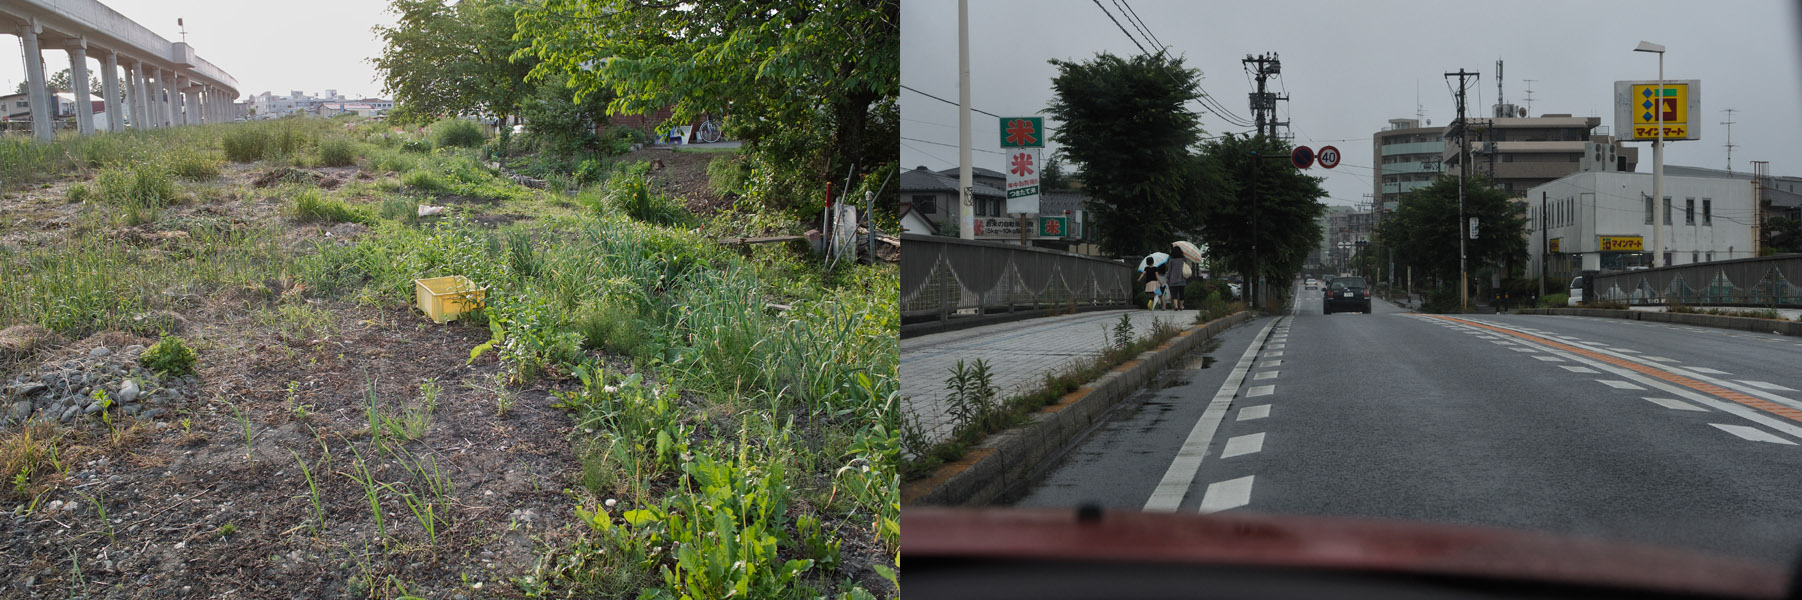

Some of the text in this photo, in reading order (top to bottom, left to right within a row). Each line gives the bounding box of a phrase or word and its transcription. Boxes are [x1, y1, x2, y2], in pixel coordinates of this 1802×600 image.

[1005, 119, 1037, 145] 米
[1636, 127, 1685, 136] マインマート
[1322, 152, 1336, 162] 40
[1011, 152, 1034, 176] 米
[1010, 189, 1036, 197] つきたて米
[1045, 219, 1061, 235] 米
[1612, 240, 1642, 248] マインマート
